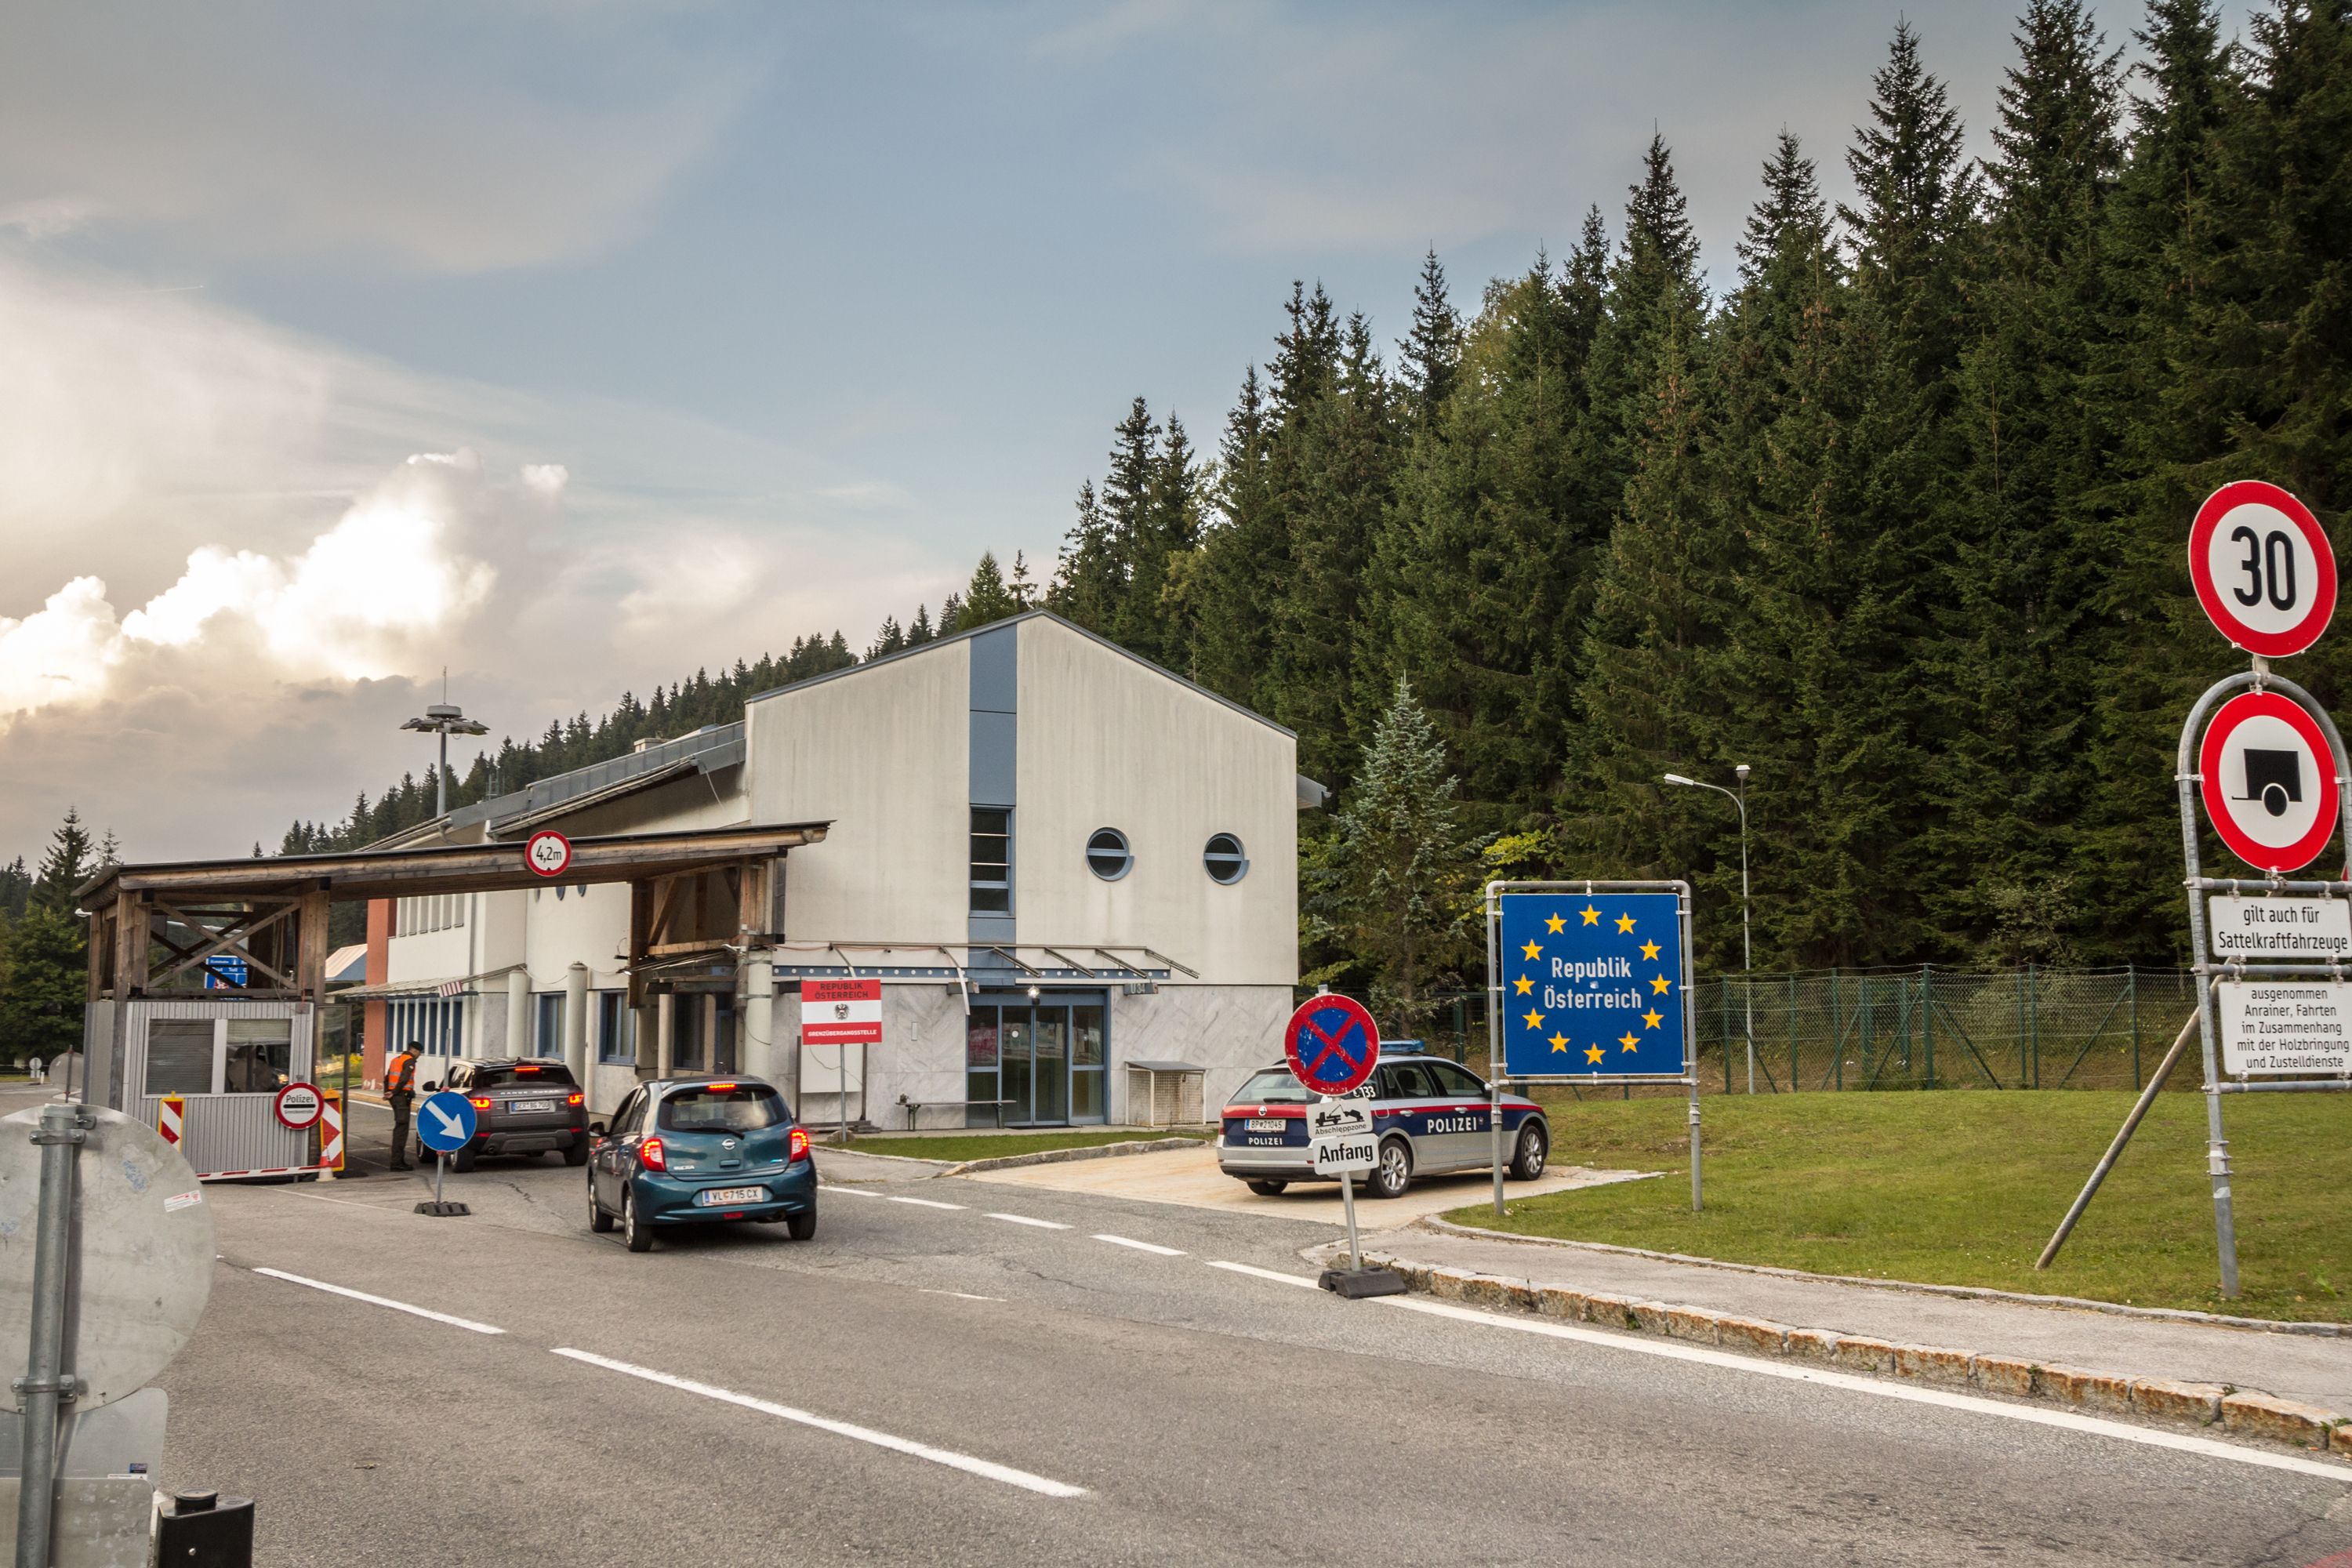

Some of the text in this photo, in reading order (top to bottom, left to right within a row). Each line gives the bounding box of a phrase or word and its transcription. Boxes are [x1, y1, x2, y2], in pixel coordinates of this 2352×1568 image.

[2231, 525, 2296, 611] 30
[536, 845, 561, 863] 4,2m
[2243, 904, 2320, 926] gilt auch für
[2218, 931, 2348, 953] Sattelkraftfahrzeuge
[1552, 956, 1632, 983] Republik
[815, 991, 869, 1000] ÖSTERREICH
[1544, 985, 1642, 1009] Österreich
[2251, 989, 2328, 1002] ausgenommen
[2245, 1004, 2337, 1018] Anrainer, Fahrten
[2241, 1021, 2343, 1036] im Zusammenhang
[2237, 1037, 2350, 1053] mit der Holzbringung
[2246, 1054, 2344, 1068] und Zustelldienste
[285, 1094, 314, 1103] Polizei
[1359, 1085, 1376, 1098] 133
[1315, 1123, 1367, 1136] Abschleppzone
[1427, 1116, 1477, 1134] POLIZEI
[1248, 1137, 1283, 1145] POLIZEI
[1319, 1143, 1374, 1163] Anfang
